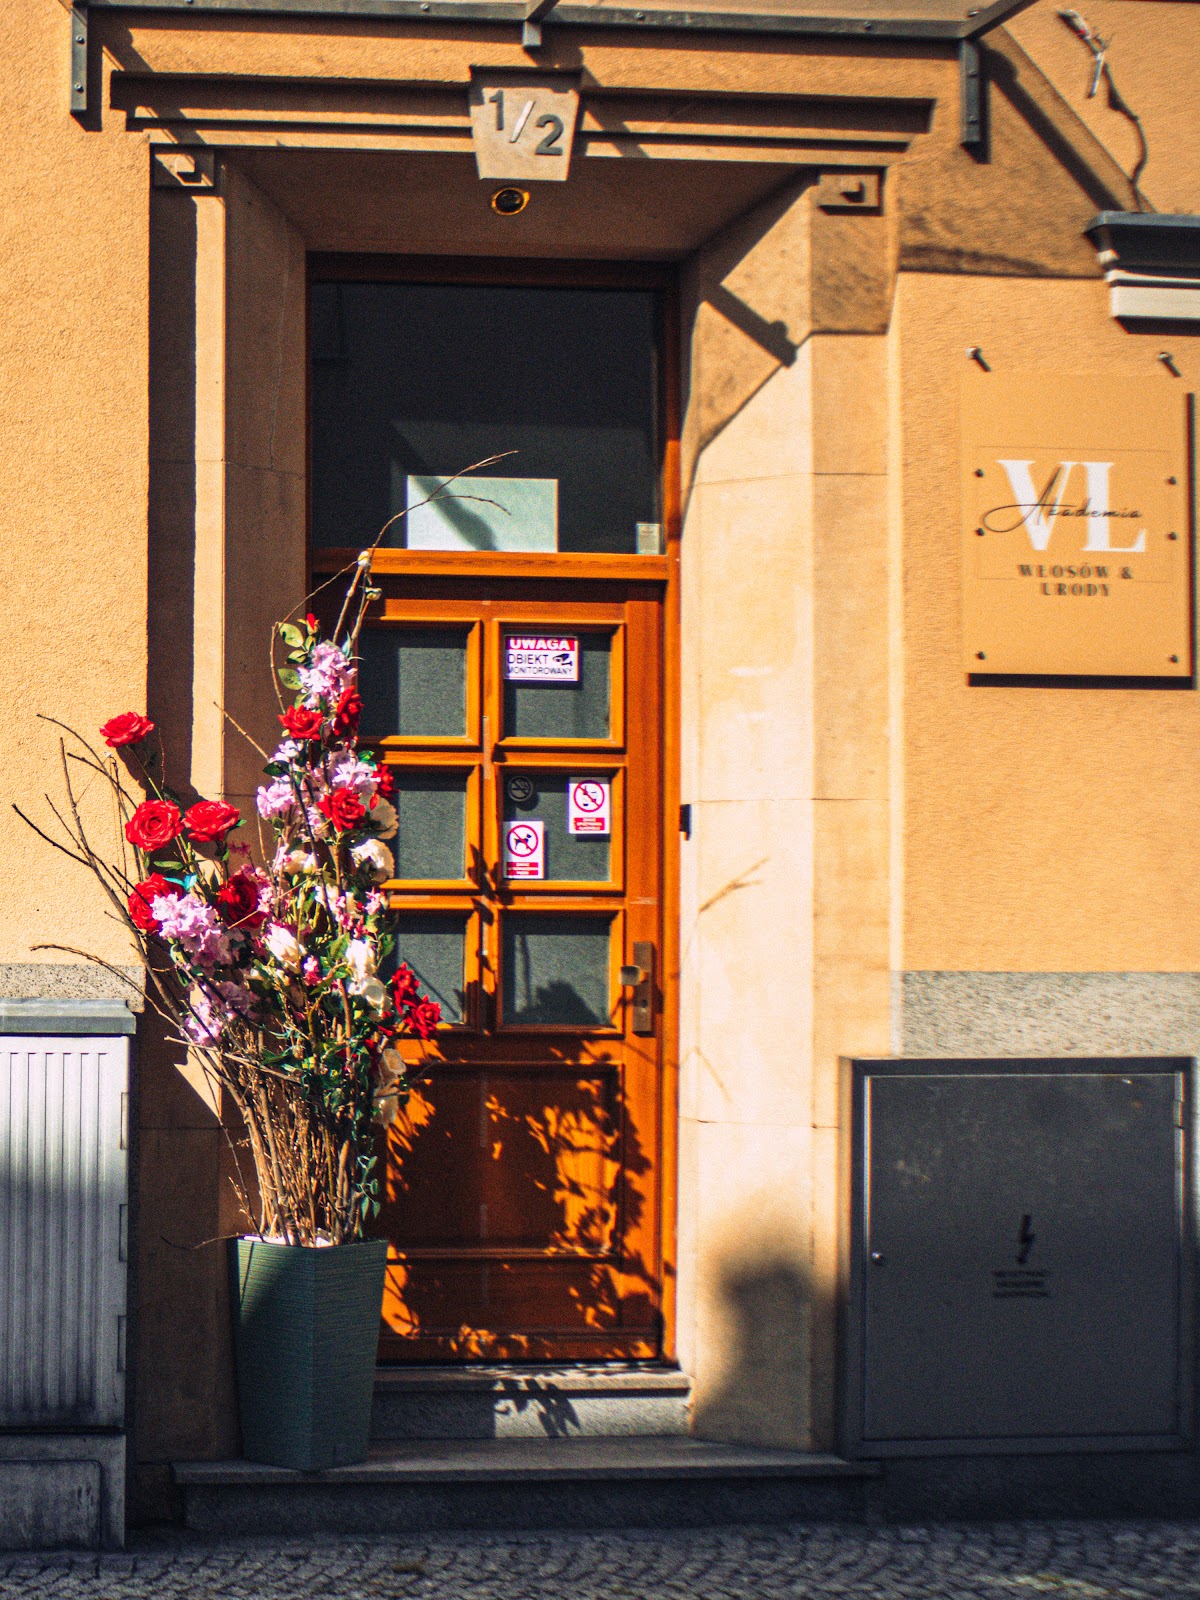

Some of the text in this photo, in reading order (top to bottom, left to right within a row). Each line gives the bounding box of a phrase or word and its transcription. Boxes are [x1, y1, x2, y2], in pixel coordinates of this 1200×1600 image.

[489, 89, 565, 156] 1/2
[982, 466, 1144, 534] Akademia
[995, 459, 1147, 553] VL
[1019, 562, 1134, 580] WŁOSÓW &
[508, 653, 549, 665] OBIEKT
[509, 638, 570, 650] UWAGA
